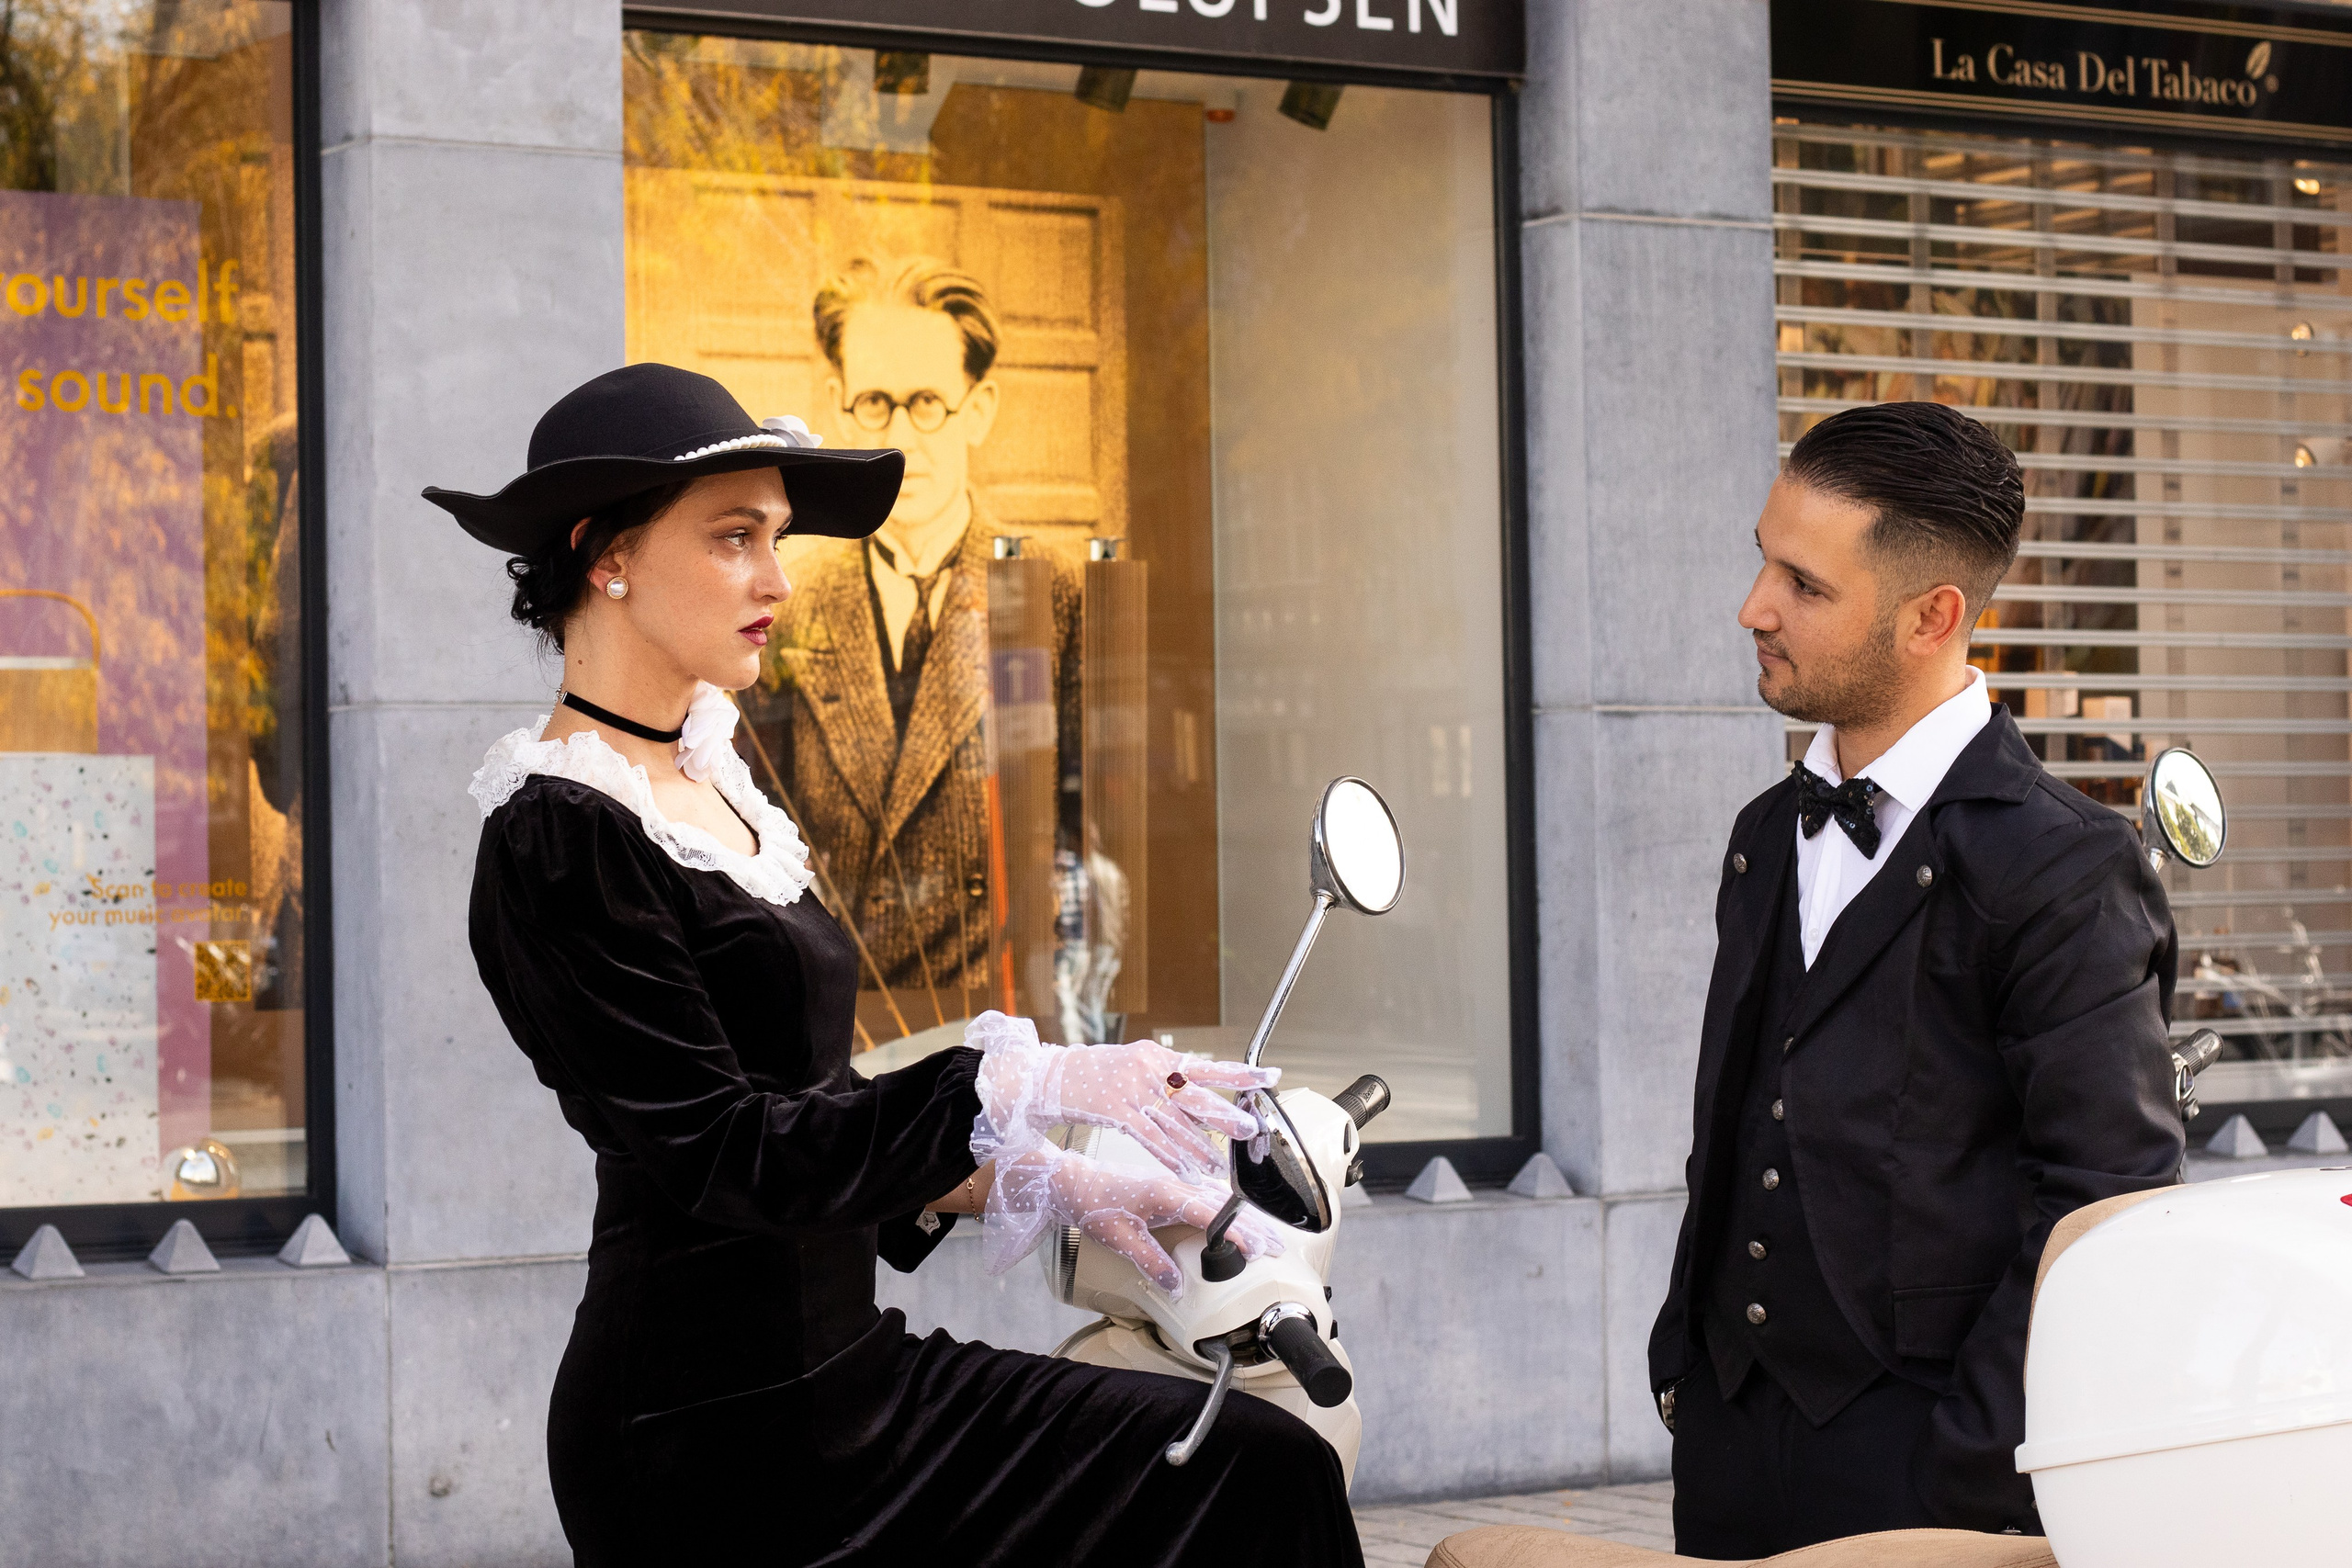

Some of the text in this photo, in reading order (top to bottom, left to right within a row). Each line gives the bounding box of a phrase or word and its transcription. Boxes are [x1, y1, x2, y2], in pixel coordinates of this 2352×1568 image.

[1931, 39, 2258, 107] La Casa Del Tabaco
[0, 259, 239, 323] ourself
[18, 353, 238, 418] sound.
[49, 910, 100, 931] your
[105, 904, 165, 924] music
[91, 877, 248, 899] Scan to create
